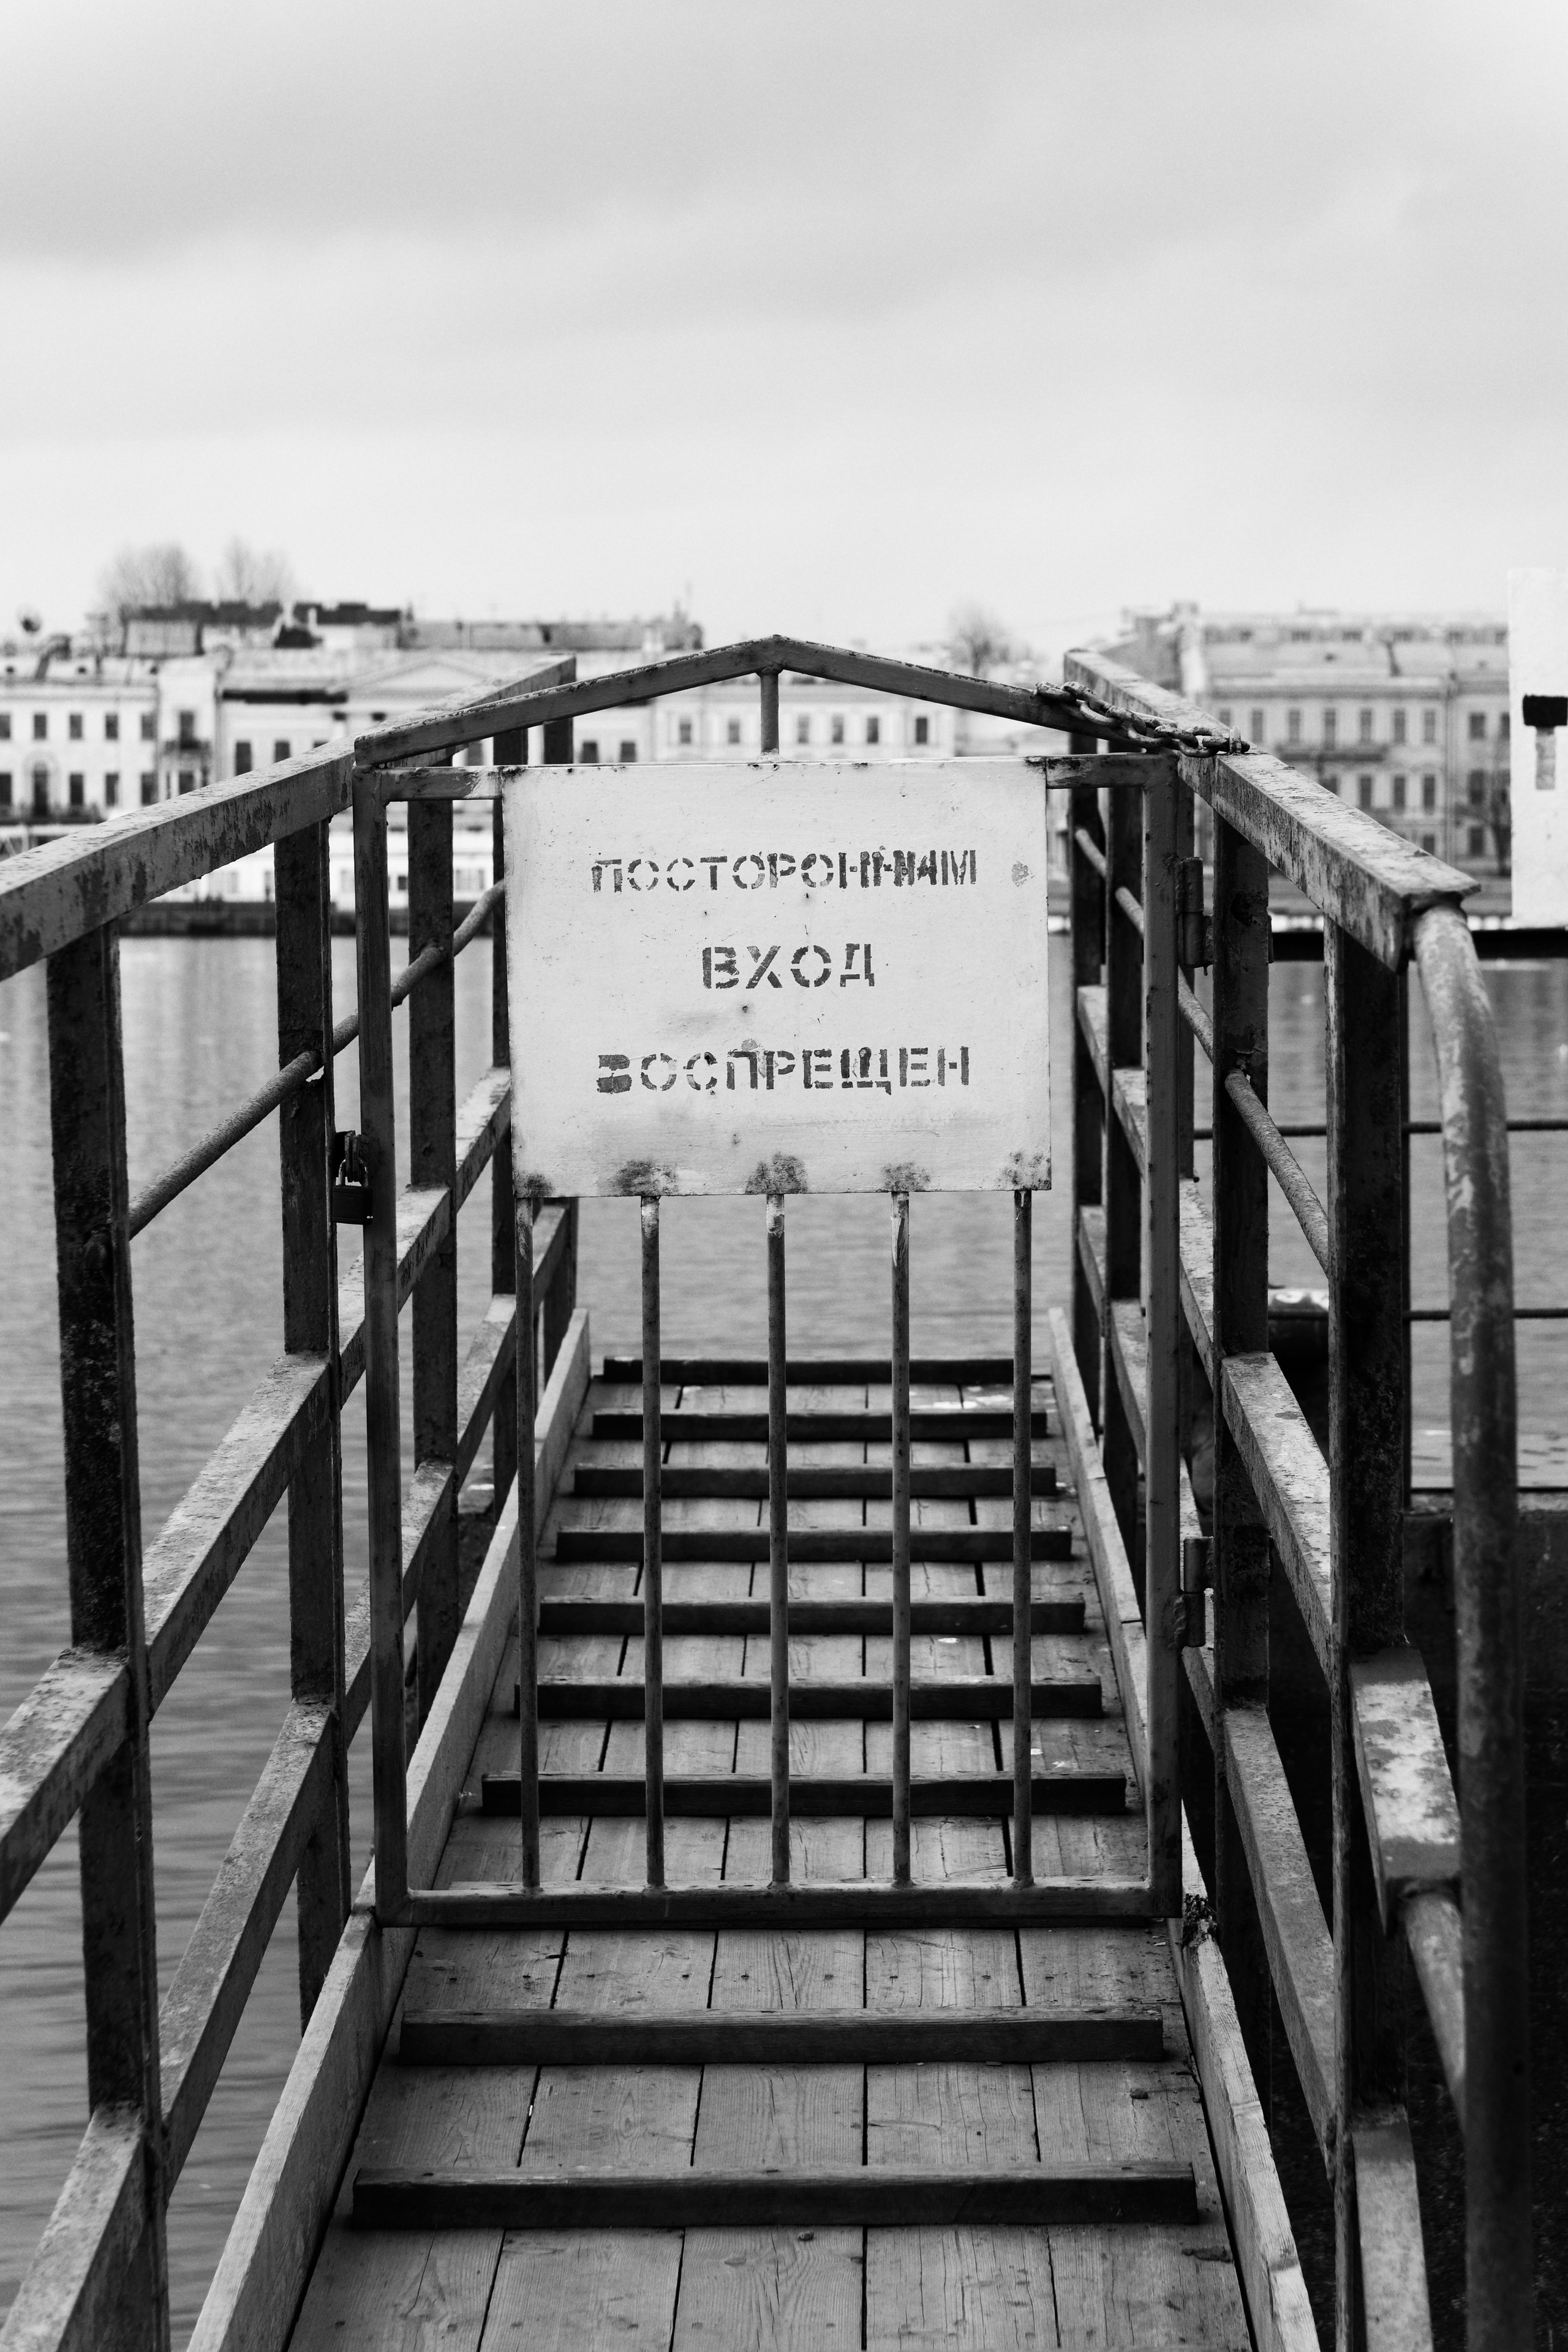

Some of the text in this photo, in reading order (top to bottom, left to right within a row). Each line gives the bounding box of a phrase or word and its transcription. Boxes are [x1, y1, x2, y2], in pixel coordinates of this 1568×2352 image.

[591, 850, 977, 893] ПОСТОРОННИМ
[702, 943, 875, 990] ВХОД
[596, 1045, 970, 1096] ВОСПРЕЩЕН
